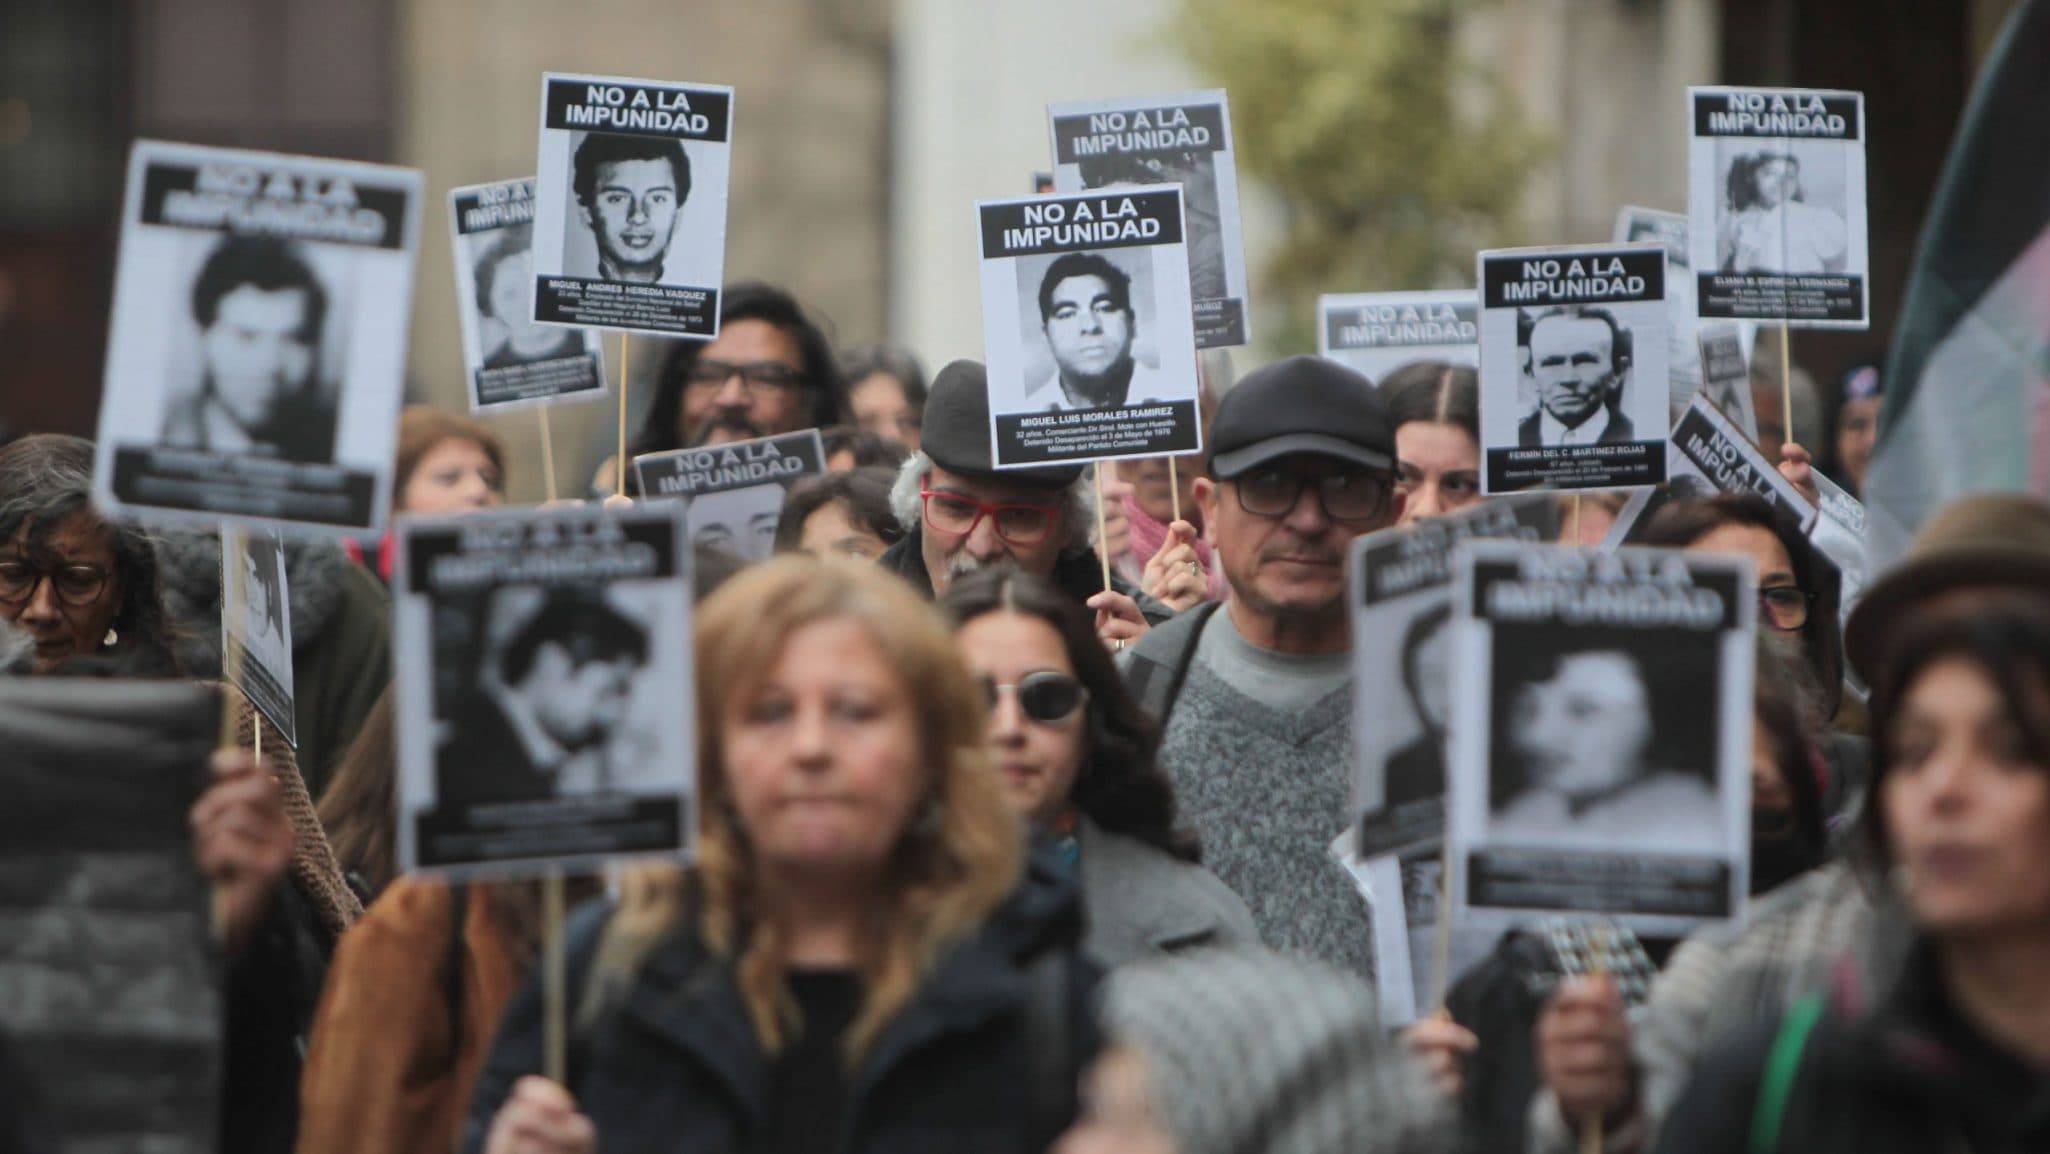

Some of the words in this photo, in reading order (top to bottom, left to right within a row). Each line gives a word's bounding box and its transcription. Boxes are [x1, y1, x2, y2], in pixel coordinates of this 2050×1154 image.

[587, 85, 625, 106] NO
[631, 89, 650, 108] A
[657, 91, 690, 112] LA
[1728, 93, 1766, 112] NO
[1770, 95, 1789, 113] A
[1794, 95, 1827, 114] LA
[566, 104, 709, 133] IMPUNIDAD
[1090, 112, 1126, 133] NO
[1132, 110, 1151, 130] A
[1157, 108, 1190, 126] LA
[1709, 111, 1846, 135] IMPUNIDAD
[1073, 126, 1210, 156] IMPUNIDAD
[478, 184, 507, 204] NO
[512, 182, 529, 200] A
[466, 201, 536, 226] IMPUNI
[1024, 203, 1066, 225] NO
[1073, 201, 1094, 221] A
[1101, 198, 1138, 219] LA
[1004, 218, 1160, 249] IMPUNIDAD
[1522, 260, 1560, 279] NO
[1568, 258, 1585, 276] A
[1592, 257, 1626, 276] LA
[549, 280, 582, 290] MIGUEL
[1504, 276, 1645, 300] IMPUNIDAD
[1358, 306, 1397, 324] NO
[1402, 304, 1420, 322] A
[1426, 304, 1458, 320] LA
[1342, 321, 1476, 344] IMPUNIDAD
[1021, 417, 1057, 427] MIGUEL
[1059, 414, 1080, 424] LUIS
[1082, 410, 1129, 422] MORALES
[1130, 407, 1173, 418] RAMIREZ
[675, 452, 714, 472] NO
[721, 449, 740, 466] A
[746, 441, 781, 462] LA
[1710, 430, 1738, 464] NO
[658, 456, 804, 492] IMPUNIDAD
